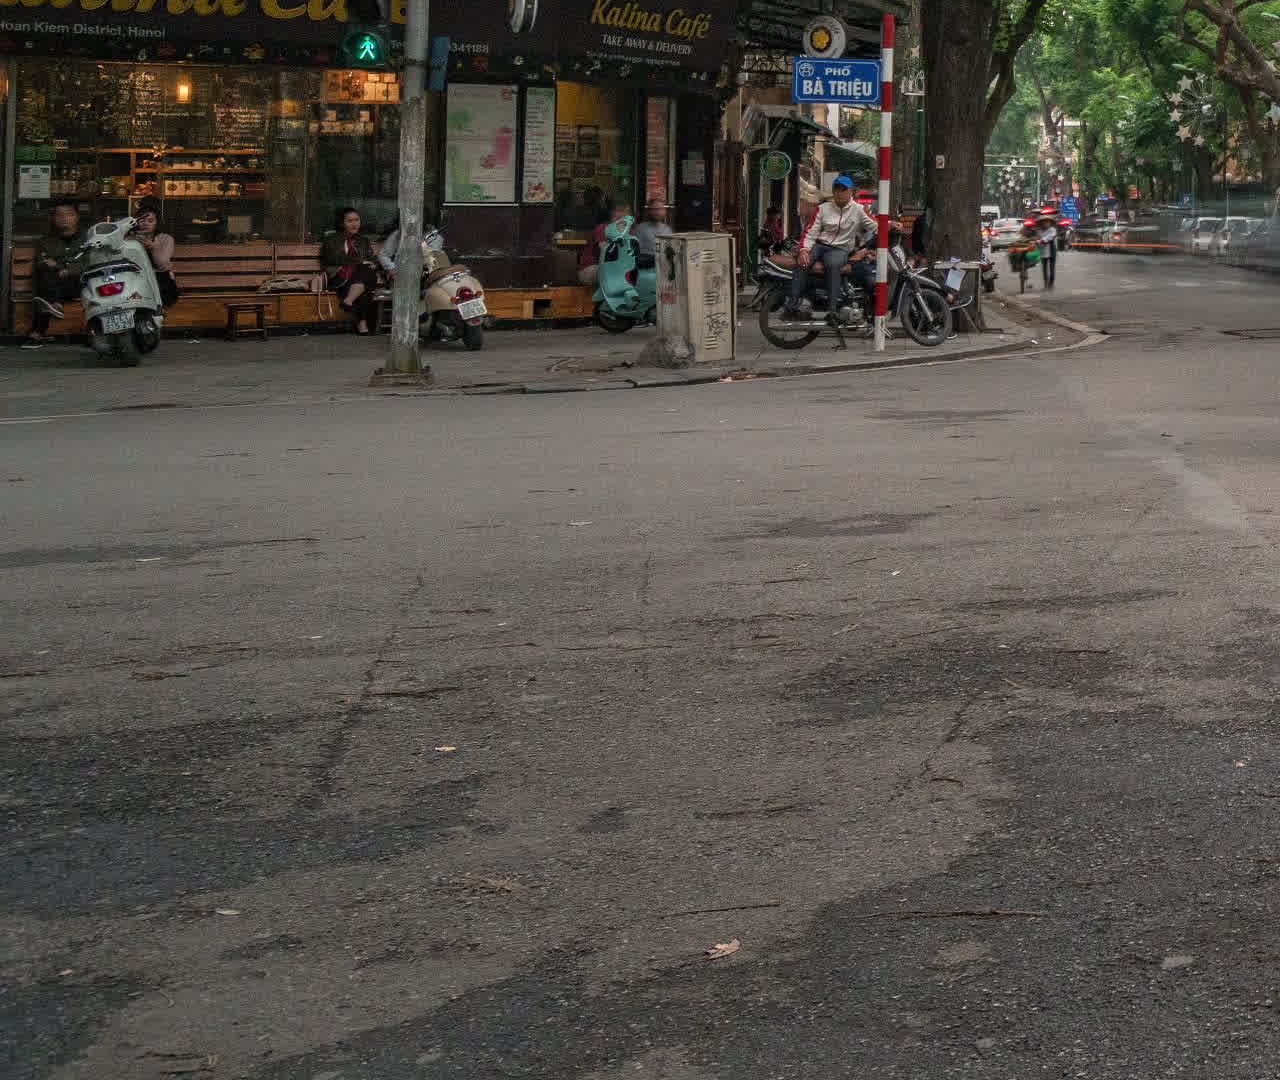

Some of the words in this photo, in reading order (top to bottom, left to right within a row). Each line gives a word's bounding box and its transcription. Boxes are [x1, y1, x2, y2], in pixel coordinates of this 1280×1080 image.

[666, 9, 713, 40] Café
[602, 34, 624, 47] TAKE
[624, 37, 646, 50] AWAY
[647, 40, 655, 50] &
[656, 41, 693, 56] DELIVERY
[824, 65, 851, 76] PHỐ
[802, 77, 824, 96] BÀ
[828, 78, 873, 100] TRIỆU
